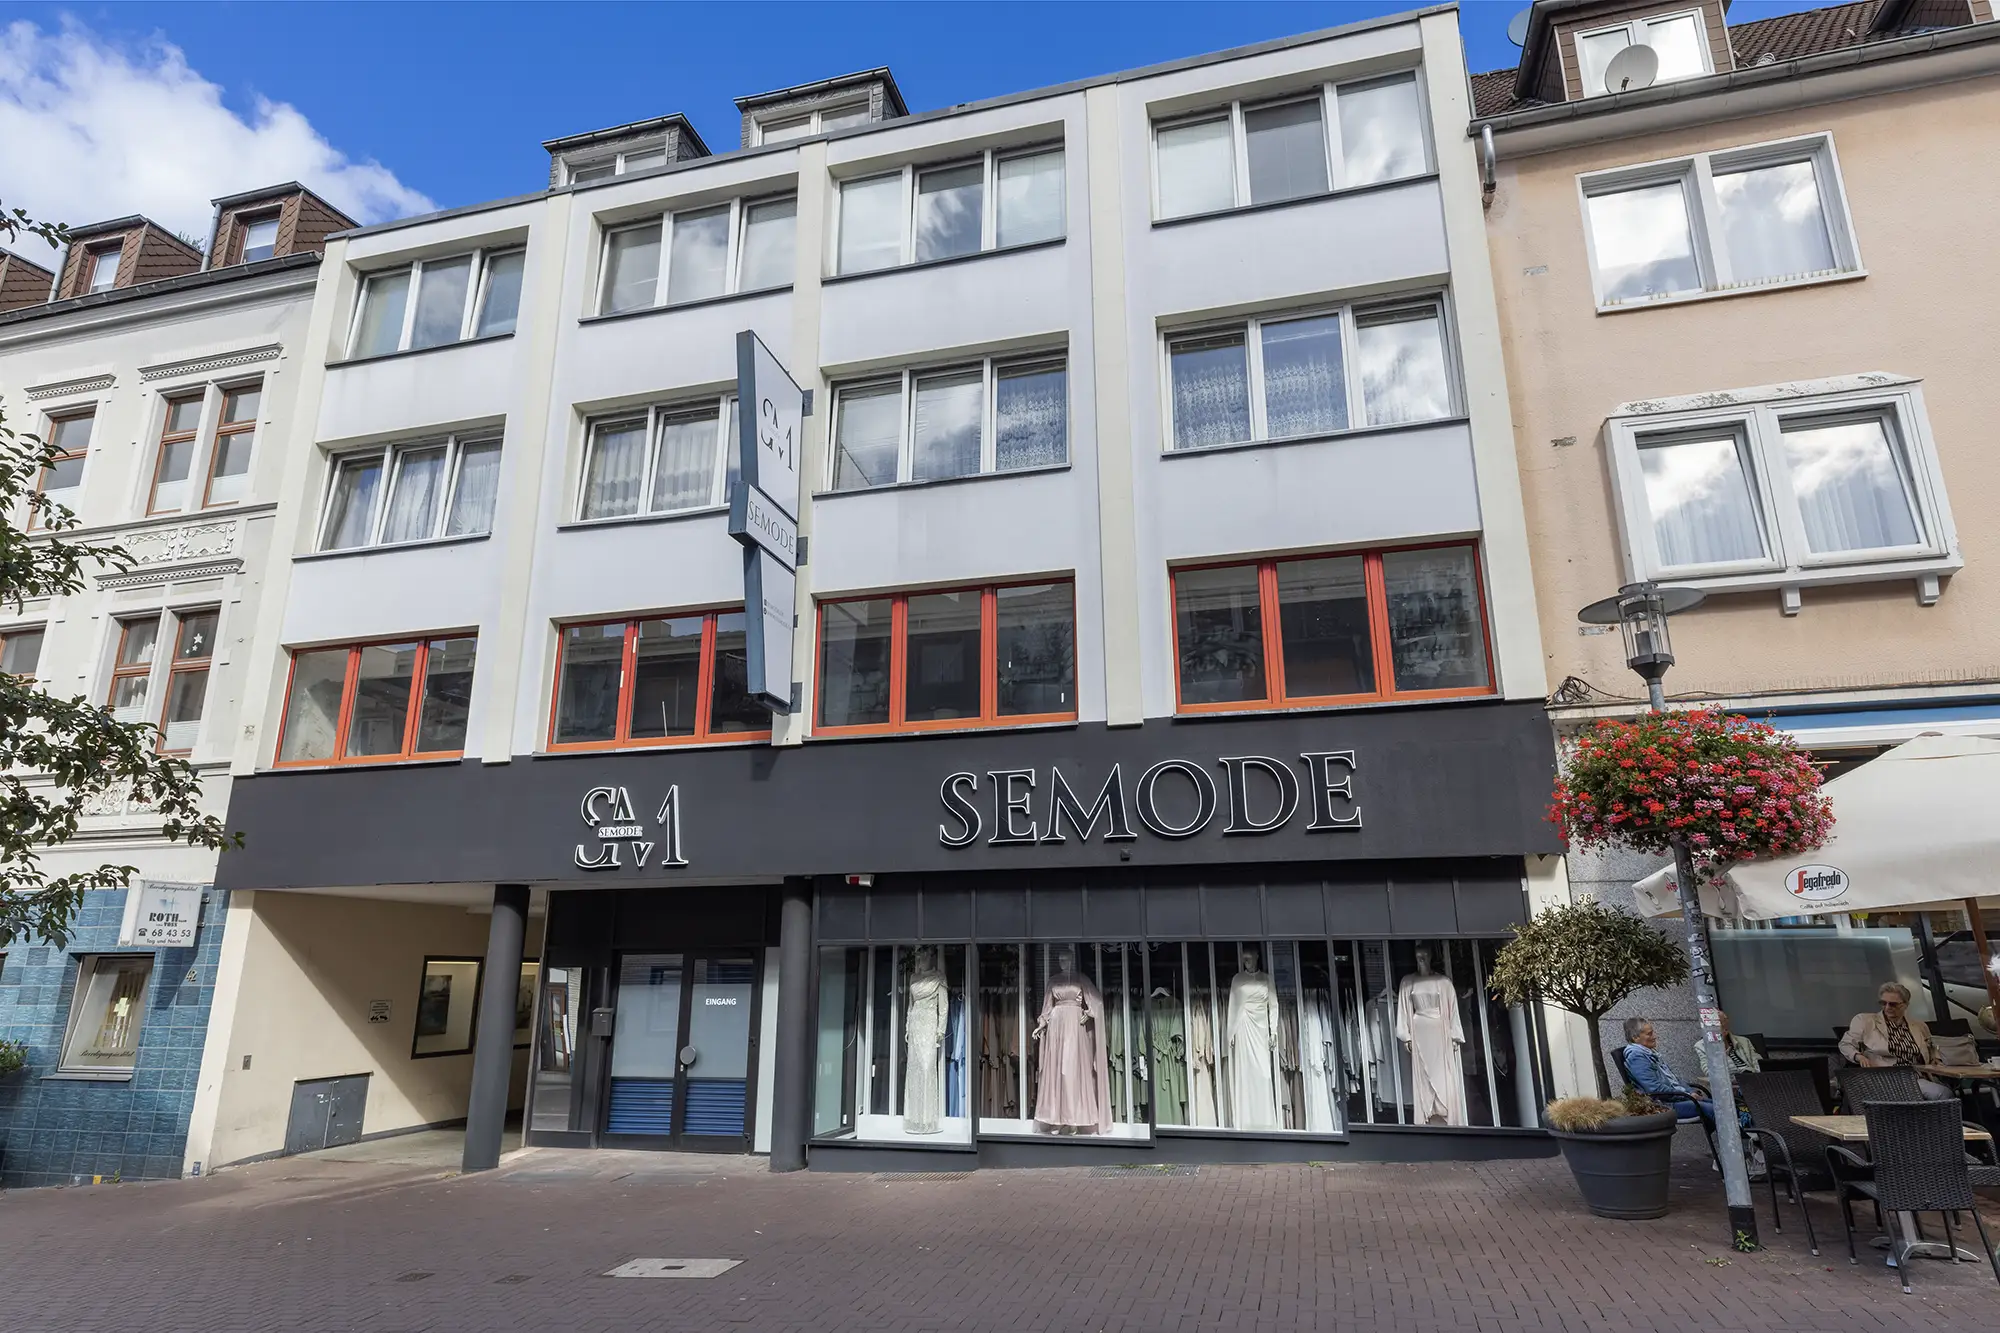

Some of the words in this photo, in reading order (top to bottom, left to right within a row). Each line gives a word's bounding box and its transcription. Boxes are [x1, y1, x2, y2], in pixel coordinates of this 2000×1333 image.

[748, 500, 794, 555] SEMODE
[939, 750, 1363, 848] SEMODE
[598, 826, 643, 838] SEMODE
[1794, 870, 1841, 894] Segafredo
[1579, 893, 1593, 904] 38
[148, 912, 179, 923] ROTH
[151, 929, 163, 937] 68
[166, 929, 178, 937] 43
[180, 929, 191, 938] 53
